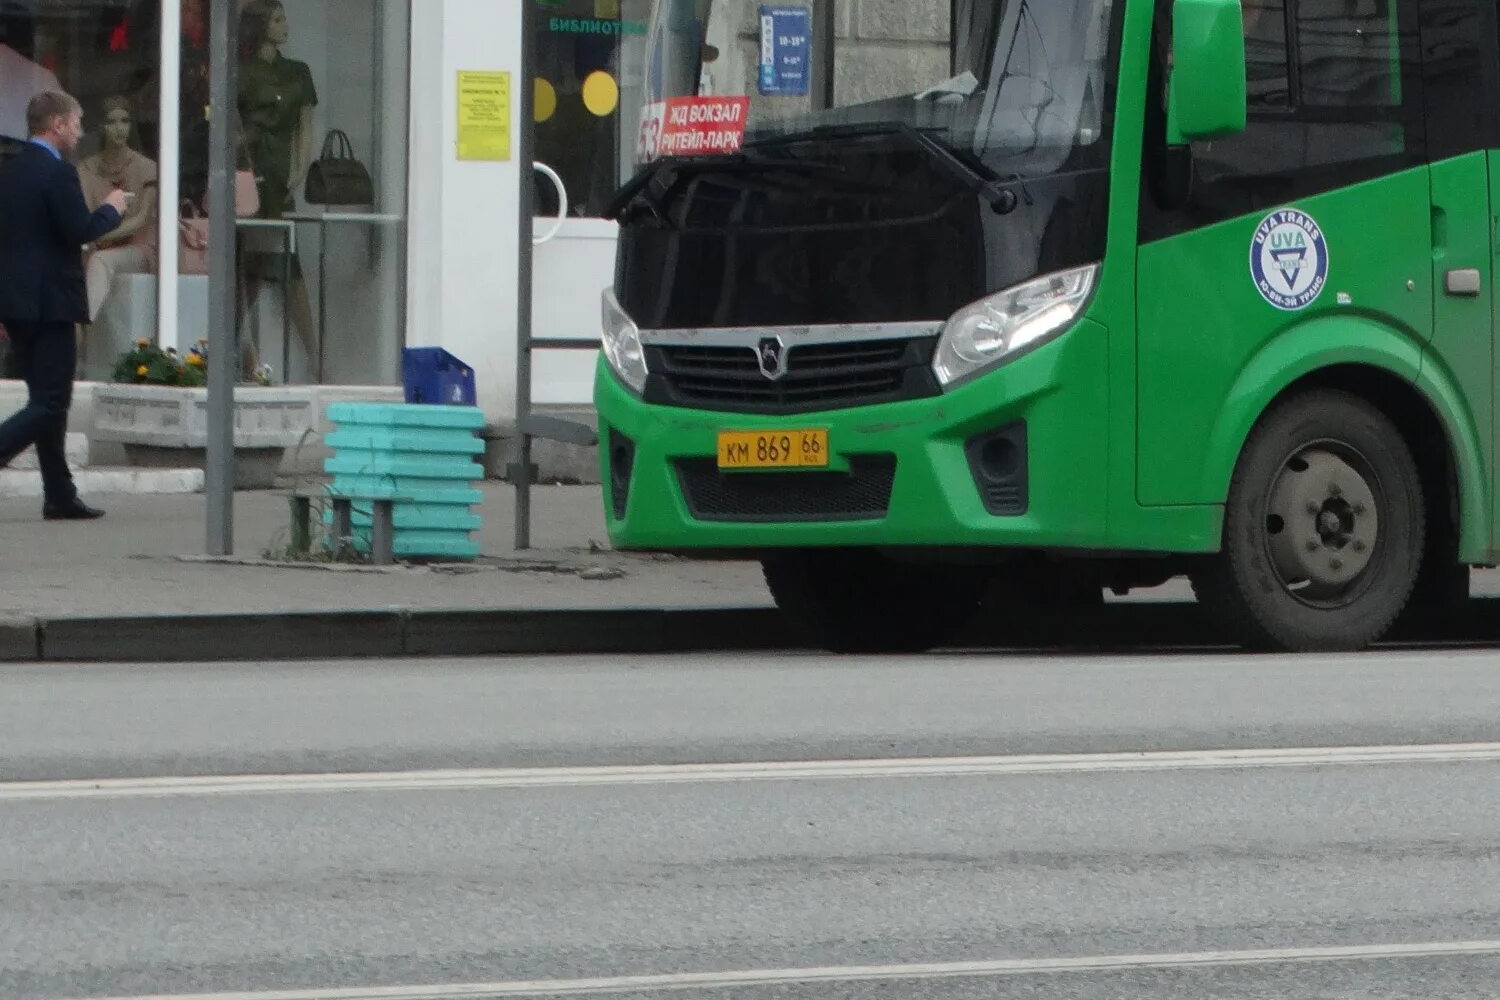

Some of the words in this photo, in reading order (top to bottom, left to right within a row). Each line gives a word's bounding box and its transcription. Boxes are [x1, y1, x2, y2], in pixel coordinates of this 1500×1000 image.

[670, 105, 689, 126] ЖД
[689, 103, 741, 122] ВОКЗАЛ
[661, 128, 741, 150] РИТЕЙЛ-ПАРК
[1255, 217, 1278, 244] UVA
[1279, 212, 1319, 241] TRANS
[1271, 231, 1305, 249] UVA
[757, 436, 790, 461] 869
[802, 433, 819, 453] 66
